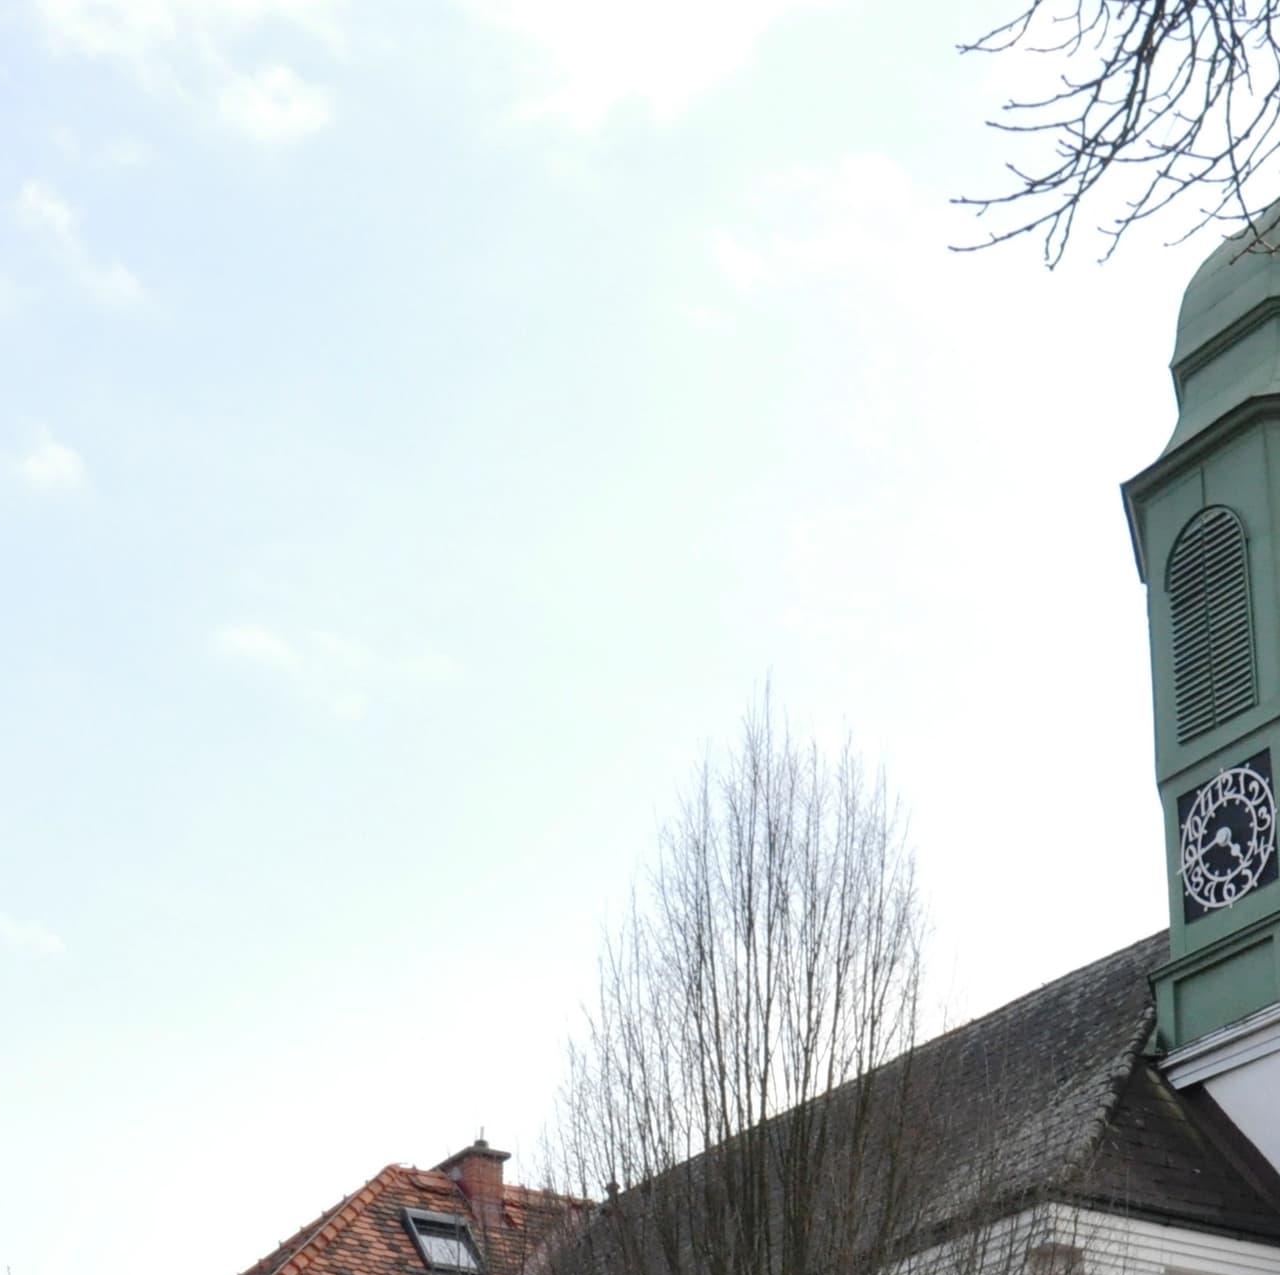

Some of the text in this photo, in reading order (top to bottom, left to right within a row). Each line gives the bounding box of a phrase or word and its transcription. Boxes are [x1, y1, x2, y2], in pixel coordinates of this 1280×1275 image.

[1215, 772, 1237, 802] 12
[1249, 781, 1267, 805] 2
[1187, 816, 1201, 842] 10
[1256, 807, 1272, 831] 3
[1191, 868, 1203, 892] 8
[1223, 880, 1236, 902] 6
